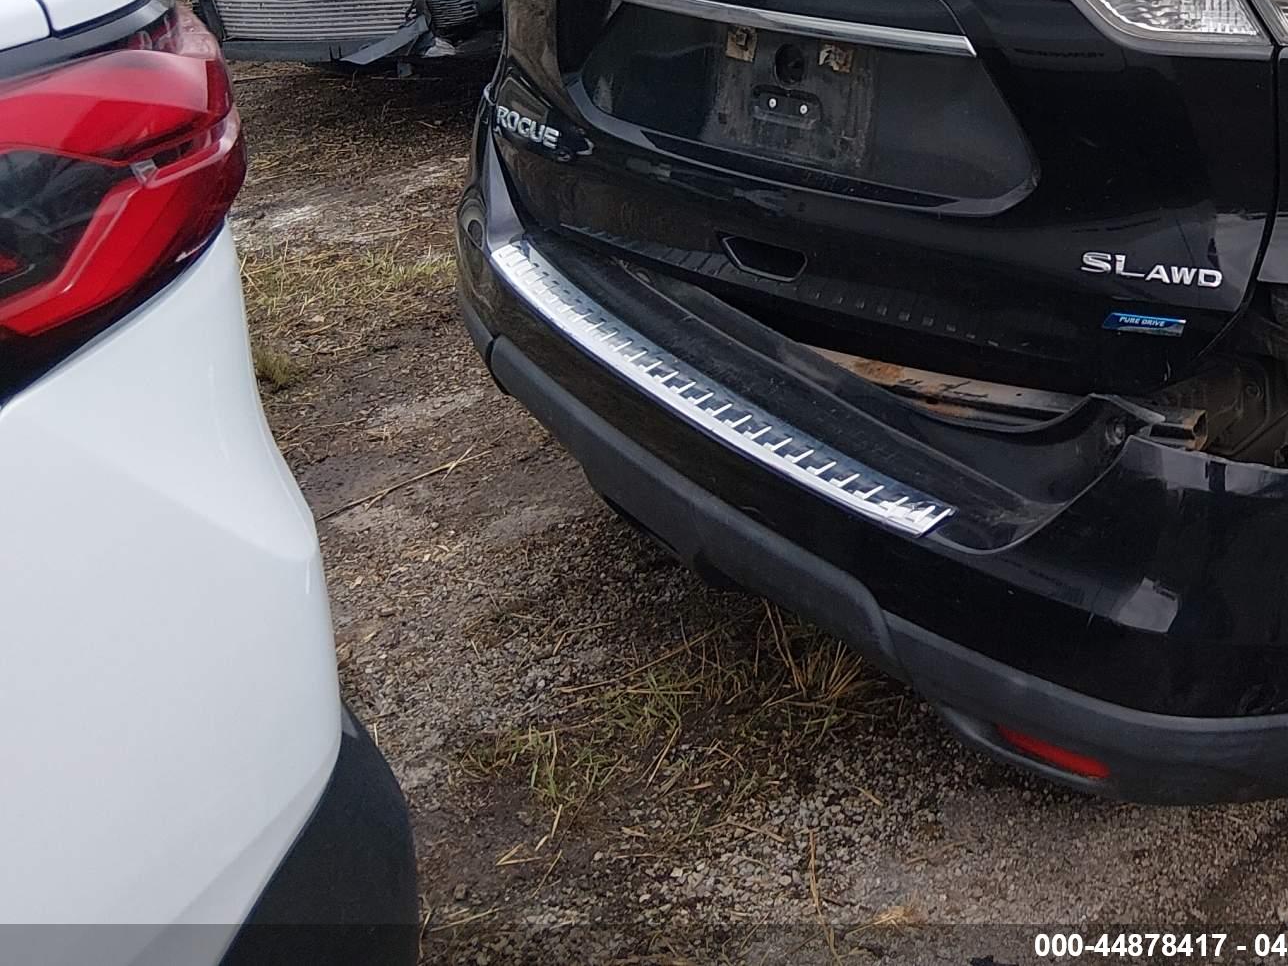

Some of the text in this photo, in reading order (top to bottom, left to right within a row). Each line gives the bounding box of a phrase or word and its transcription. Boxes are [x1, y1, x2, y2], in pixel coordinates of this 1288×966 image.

[496, 105, 560, 149] ROGUE
[1081, 251, 1223, 287] SL AWD
[1118, 315, 1166, 327] PURE DRIVE
